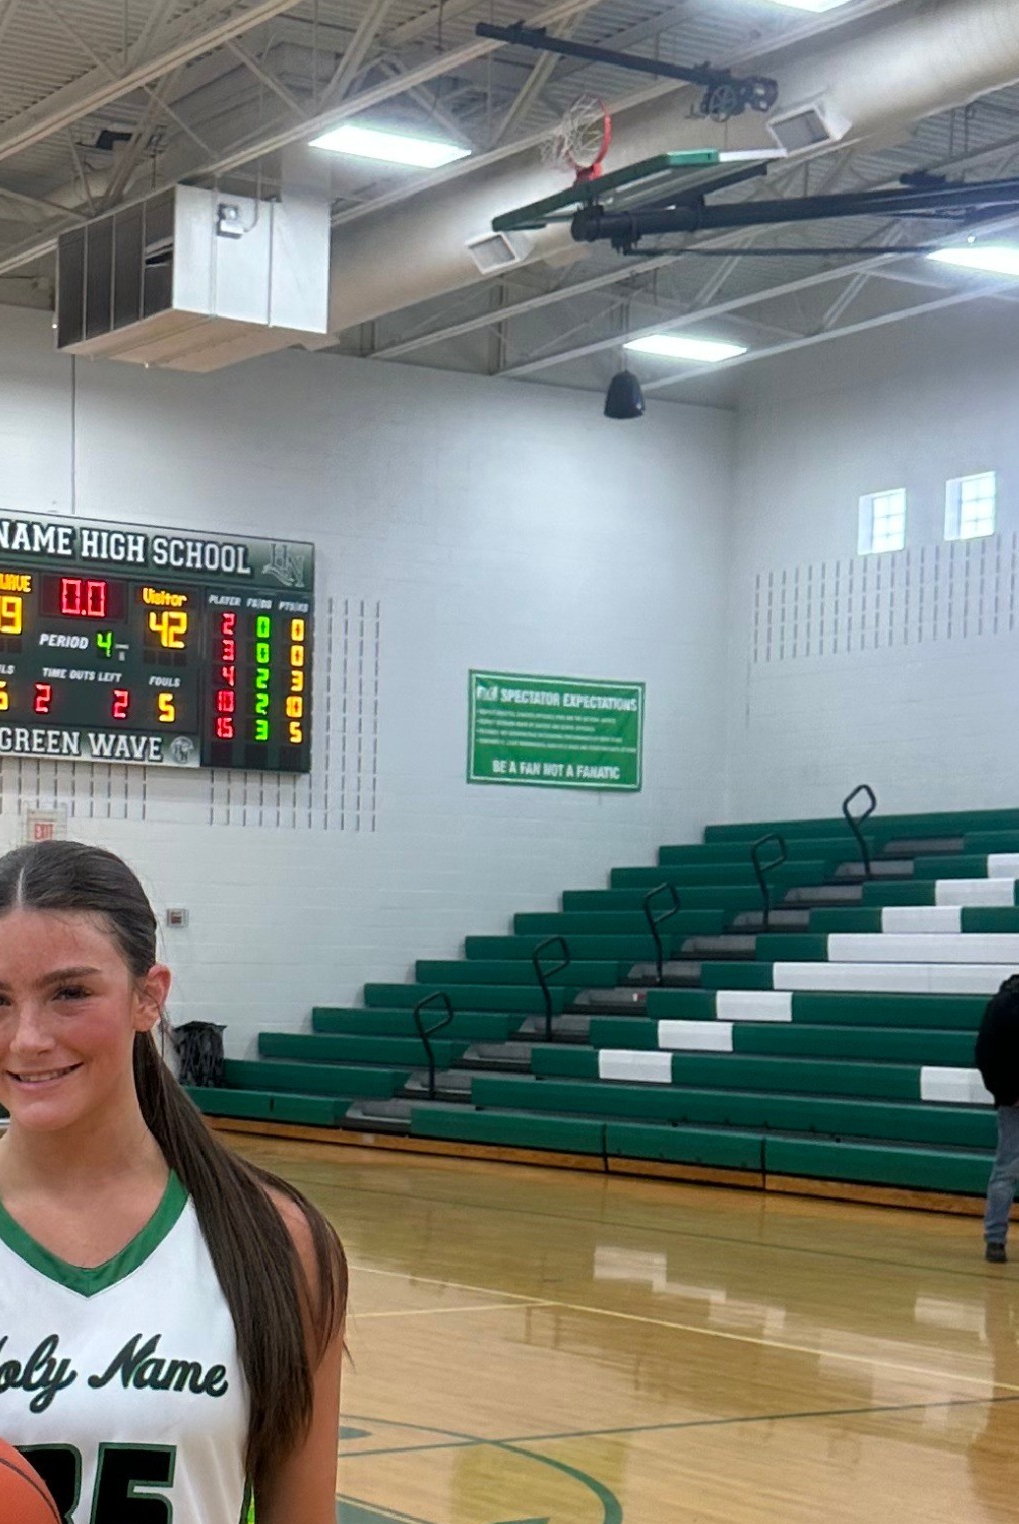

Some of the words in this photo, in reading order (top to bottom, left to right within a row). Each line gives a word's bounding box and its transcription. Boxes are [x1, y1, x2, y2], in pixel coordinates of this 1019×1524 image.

[81, 529, 145, 563] HIGH
[152, 537, 251, 575] SCHOOL
[142, 587, 187, 607] Visitor
[208, 594, 241, 607] PLAYER
[149, 611, 188, 649] 42
[222, 613, 235, 635] 2
[257, 616, 270, 638] 0
[291, 619, 304, 641] 0
[39, 633, 89, 650] PERIOD
[97, 632, 113, 658] 4
[222, 640, 234, 661] 3
[256, 643, 269, 663] 0
[291, 645, 304, 666] 0
[43, 667, 66, 678] TIME
[69, 669, 95, 680] OUTS
[97, 671, 122, 683] LEFT
[149, 676, 181, 688] FOULS
[222, 666, 234, 687] 4
[256, 668, 269, 689] 2
[291, 670, 303, 692] 3
[35, 684, 51, 713] 2
[113, 689, 129, 718] 2
[158, 693, 175, 722] 5
[256, 693, 269, 714] 2
[500, 688, 560, 707] SPECTATOR
[563, 692, 638, 712] EXPECTATIONS
[255, 719, 268, 740] 3
[289, 721, 302, 743] 5
[88, 732, 163, 761] WAVE
[492, 760, 507, 773] BE
[509, 760, 517, 774] A
[520, 761, 542, 775] FAN
[543, 763, 565, 777] NOT
[566, 764, 574, 778] A
[576, 765, 621, 780] FANATIC
[87, 1333, 229, 1398] Name
